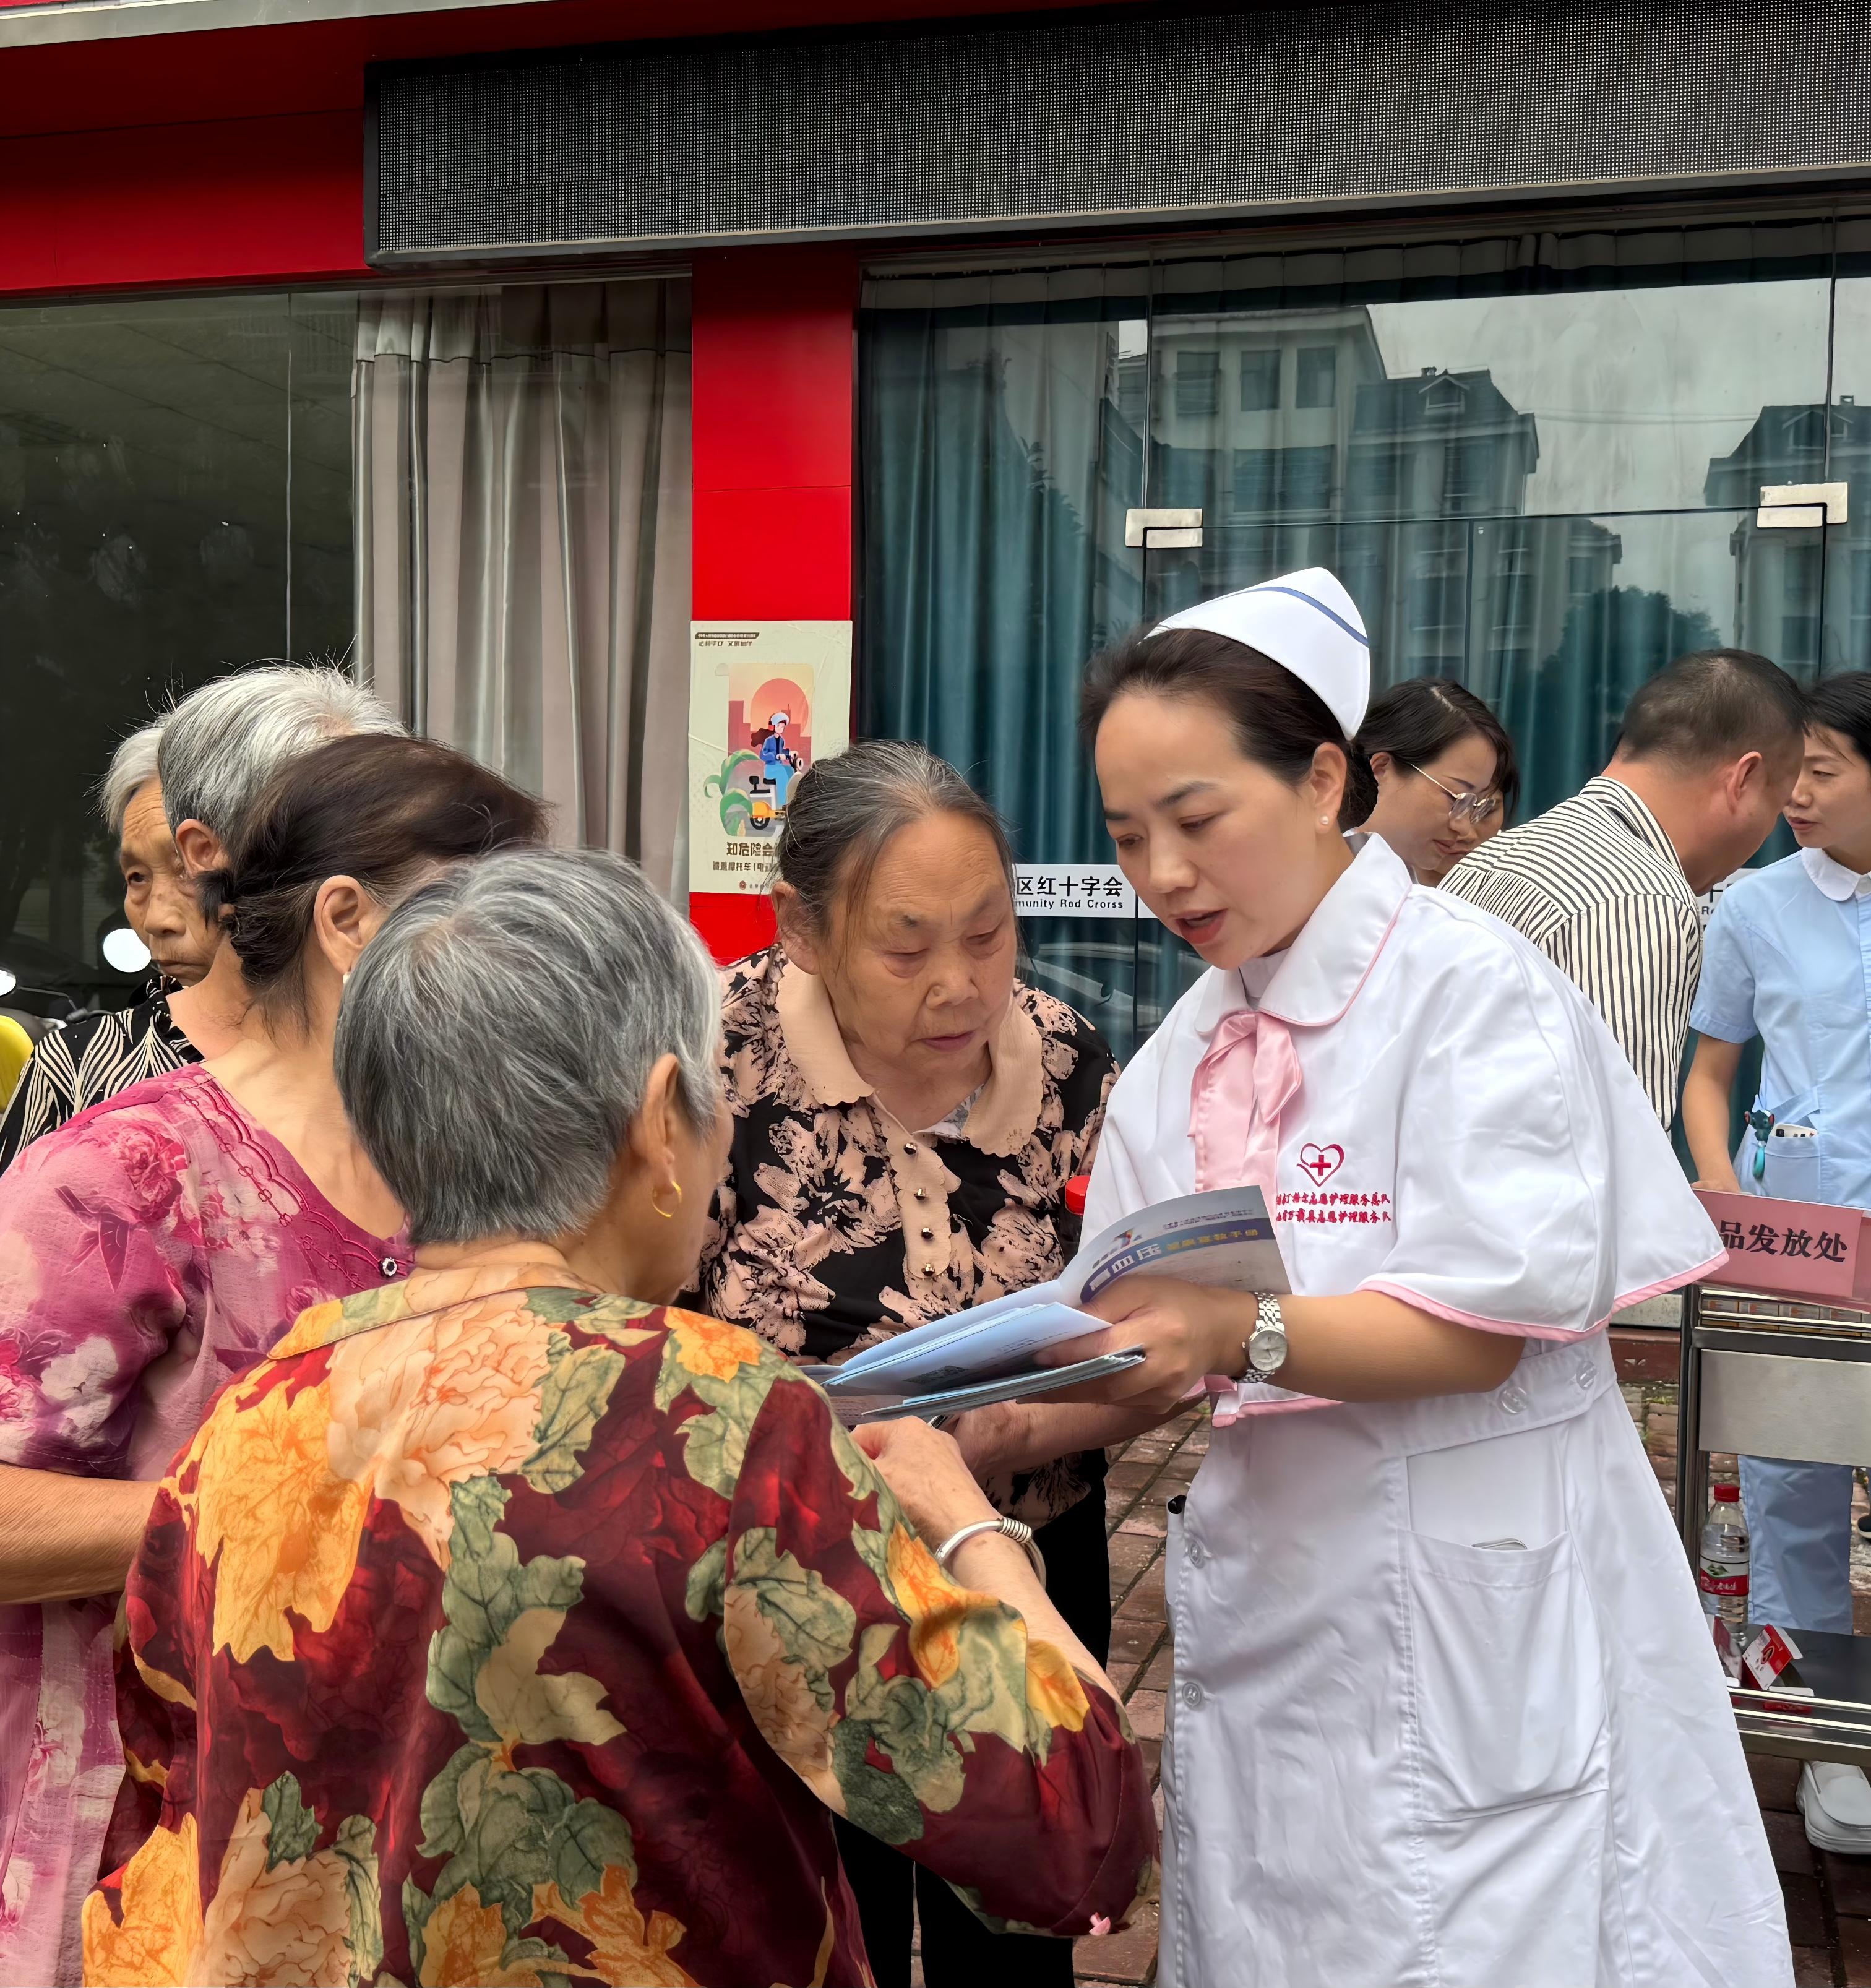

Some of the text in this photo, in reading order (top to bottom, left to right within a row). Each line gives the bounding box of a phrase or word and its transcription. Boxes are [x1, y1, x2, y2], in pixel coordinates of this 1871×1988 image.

[1017, 876, 1123, 897] 区红十字会
[1719, 1220, 1847, 1263] 品发放处
